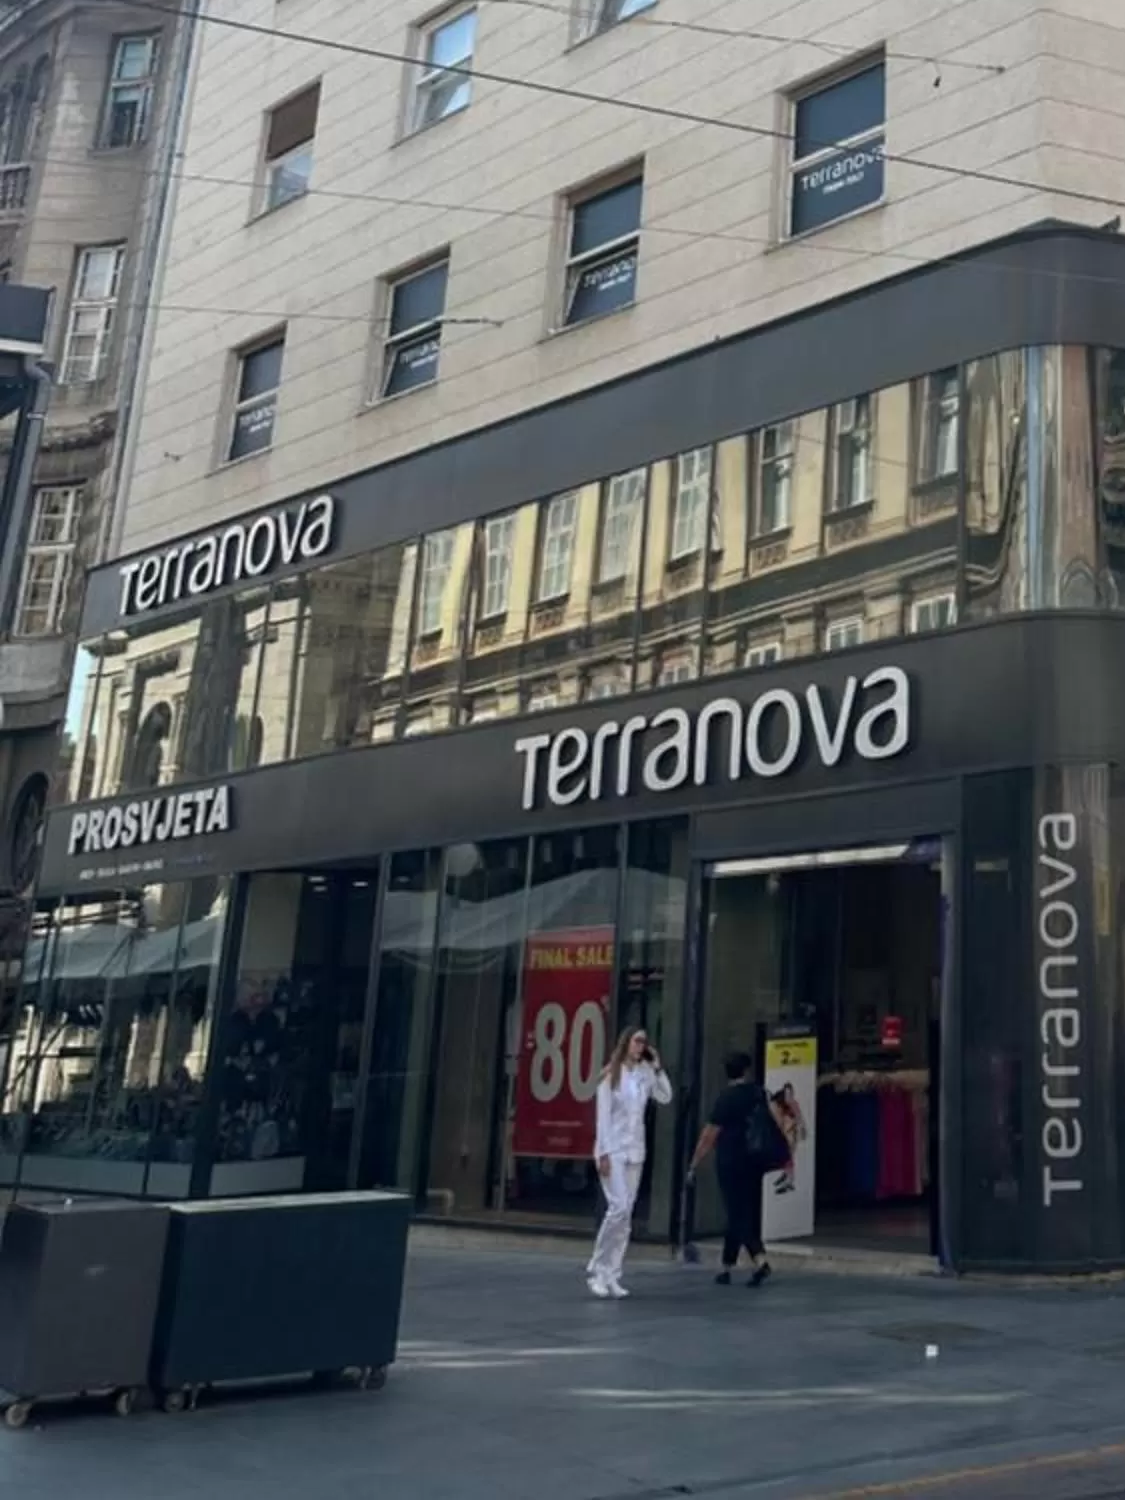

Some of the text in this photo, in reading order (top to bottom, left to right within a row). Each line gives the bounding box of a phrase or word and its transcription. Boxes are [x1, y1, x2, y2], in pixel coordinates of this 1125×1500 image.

[118, 494, 334, 616] Terranova
[515, 666, 910, 809] Terranova
[67, 784, 229, 855] PROSVJETA
[530, 944, 613, 969] FINAL SALE
[1039, 812, 1084, 1206] Terranova
[530, 1001, 605, 1102] 80
